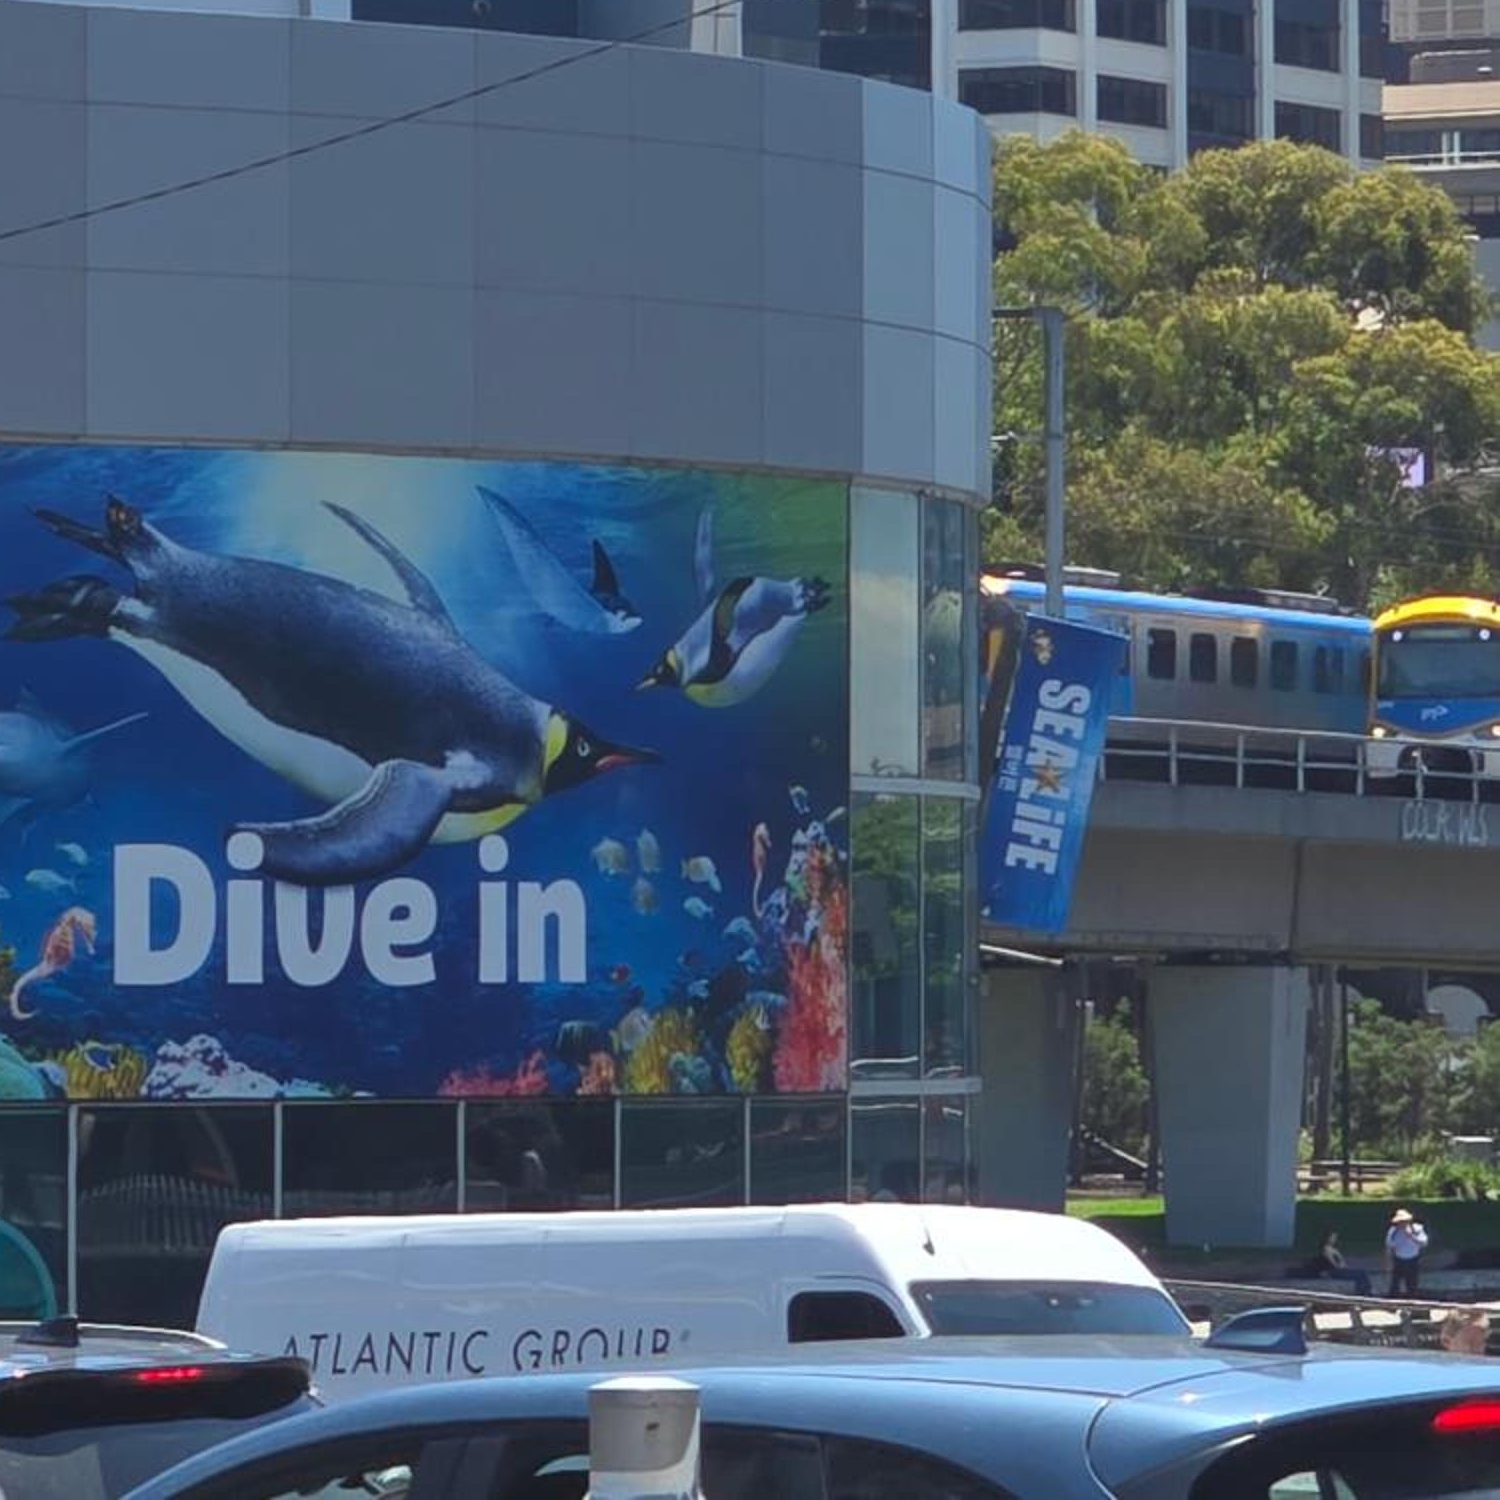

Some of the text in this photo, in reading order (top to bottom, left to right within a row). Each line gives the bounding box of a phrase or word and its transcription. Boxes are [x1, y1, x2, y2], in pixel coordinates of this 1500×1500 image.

[1024, 678, 1092, 769] SEA
[113, 832, 587, 986] Dive in
[283, 1330, 489, 1375] ATLANTIC
